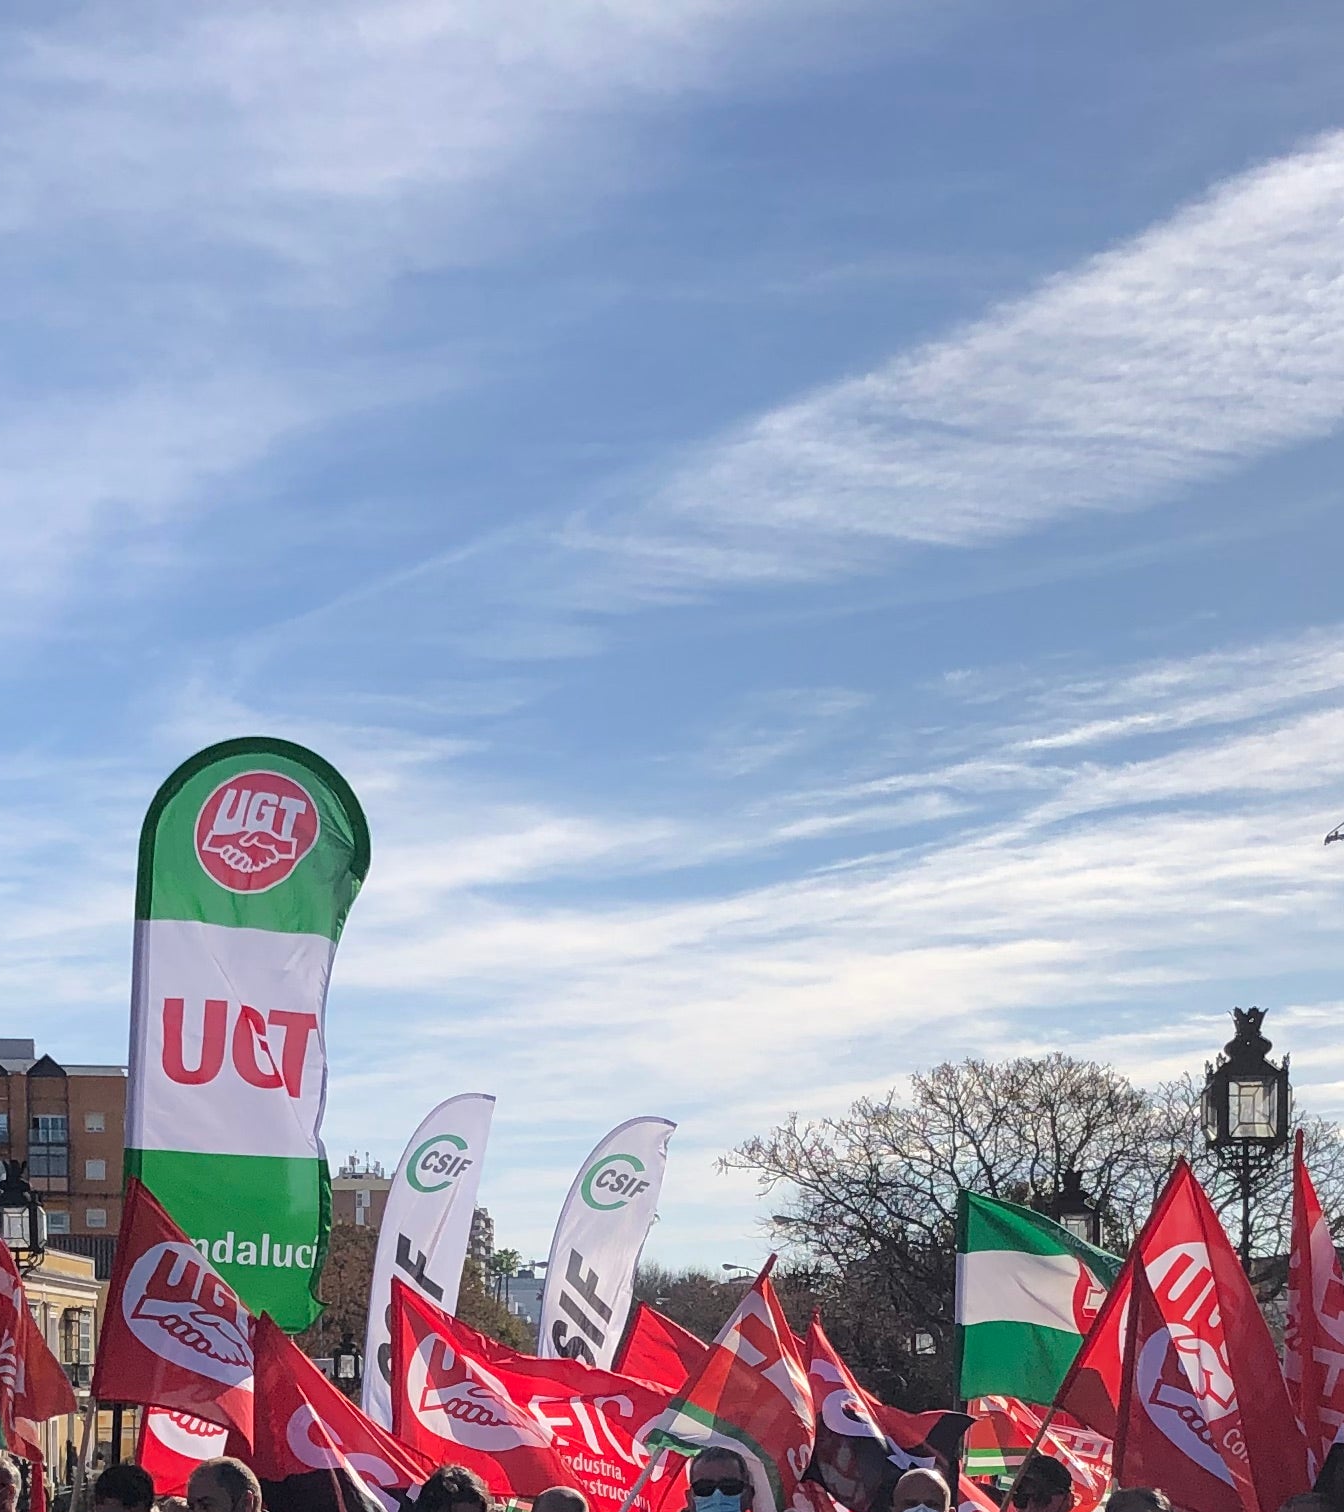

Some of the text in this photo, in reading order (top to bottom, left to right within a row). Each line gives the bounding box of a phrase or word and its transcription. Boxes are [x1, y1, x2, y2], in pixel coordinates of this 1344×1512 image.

[212, 789, 308, 840] UGT
[162, 997, 318, 1099] UGT
[146, 1249, 239, 1324] UG
[190, 1231, 320, 1269] ndalucí
[552, 1248, 613, 1367] SIF
